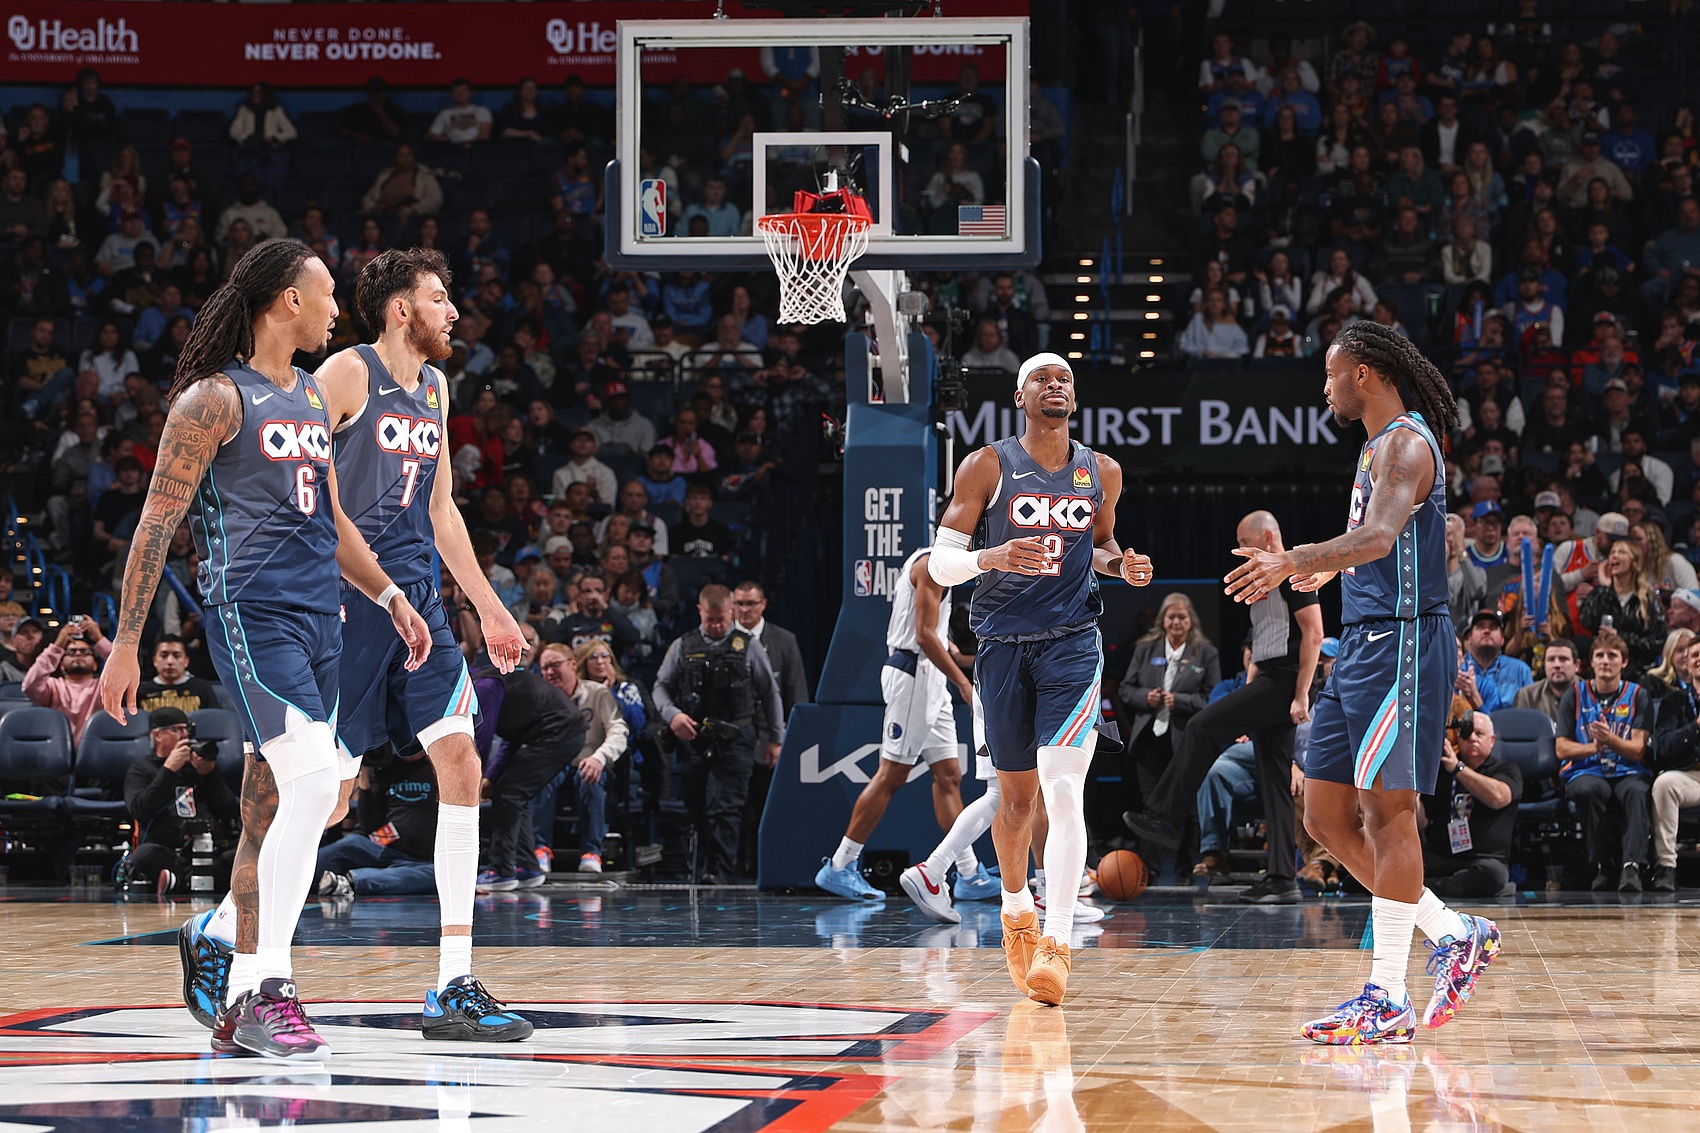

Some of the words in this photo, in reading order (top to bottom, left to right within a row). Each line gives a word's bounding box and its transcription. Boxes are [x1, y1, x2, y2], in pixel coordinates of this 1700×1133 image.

[39, 17, 140, 52] Health
[244, 43, 320, 60] NEVER
[325, 42, 442, 60] OUTDONE.
[273, 28, 340, 41] NEVER
[348, 27, 411, 41] DONE.
[258, 420, 331, 463] OKC
[376, 413, 442, 460] OKC
[1200, 400, 1338, 446] BANK
[296, 463, 316, 516] 6
[400, 458, 422, 507] 7
[864, 487, 904, 522] GET
[1009, 492, 1095, 532] OKC
[864, 523, 904, 557] THE
[1039, 532, 1065, 577] 2
[128, 524, 164, 633] SACRIFICE
